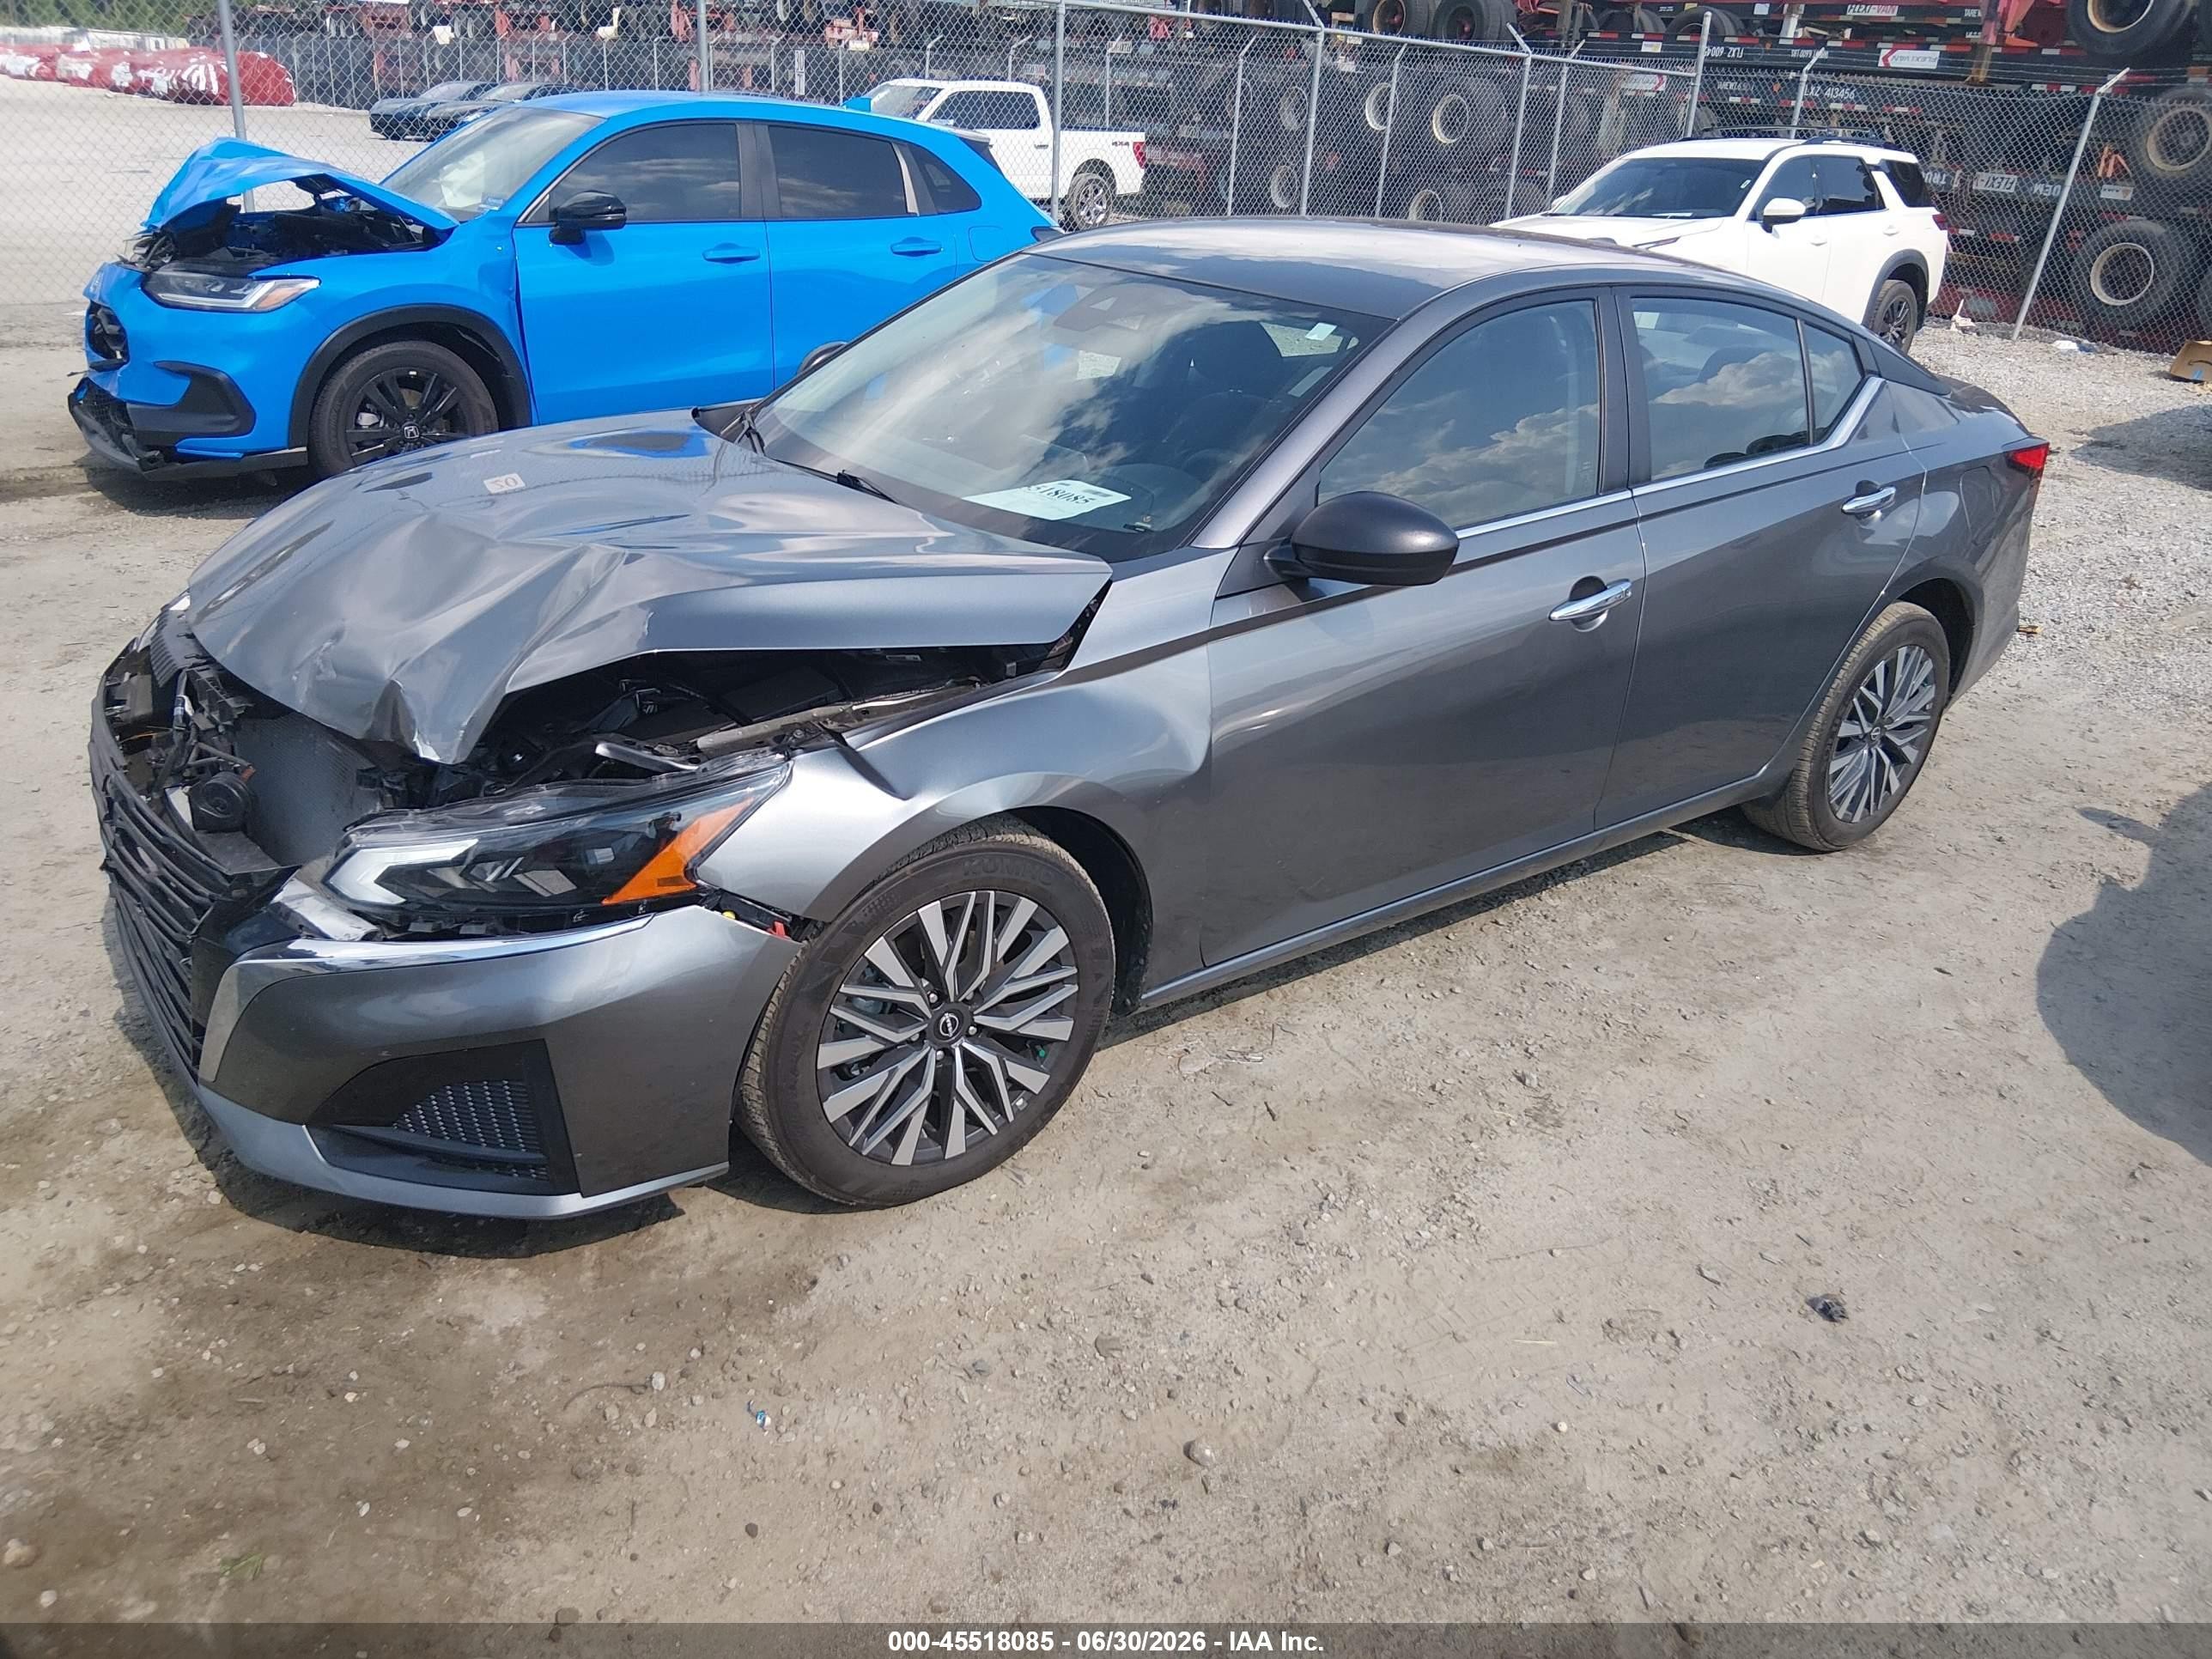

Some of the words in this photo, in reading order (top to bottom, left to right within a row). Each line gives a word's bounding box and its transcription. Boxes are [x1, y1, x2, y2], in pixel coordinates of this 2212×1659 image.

[1848, 4, 1898, 15] FLEXI-VAN
[1804, 87, 1820, 97] LXZ
[1824, 88, 1856, 100] 413456
